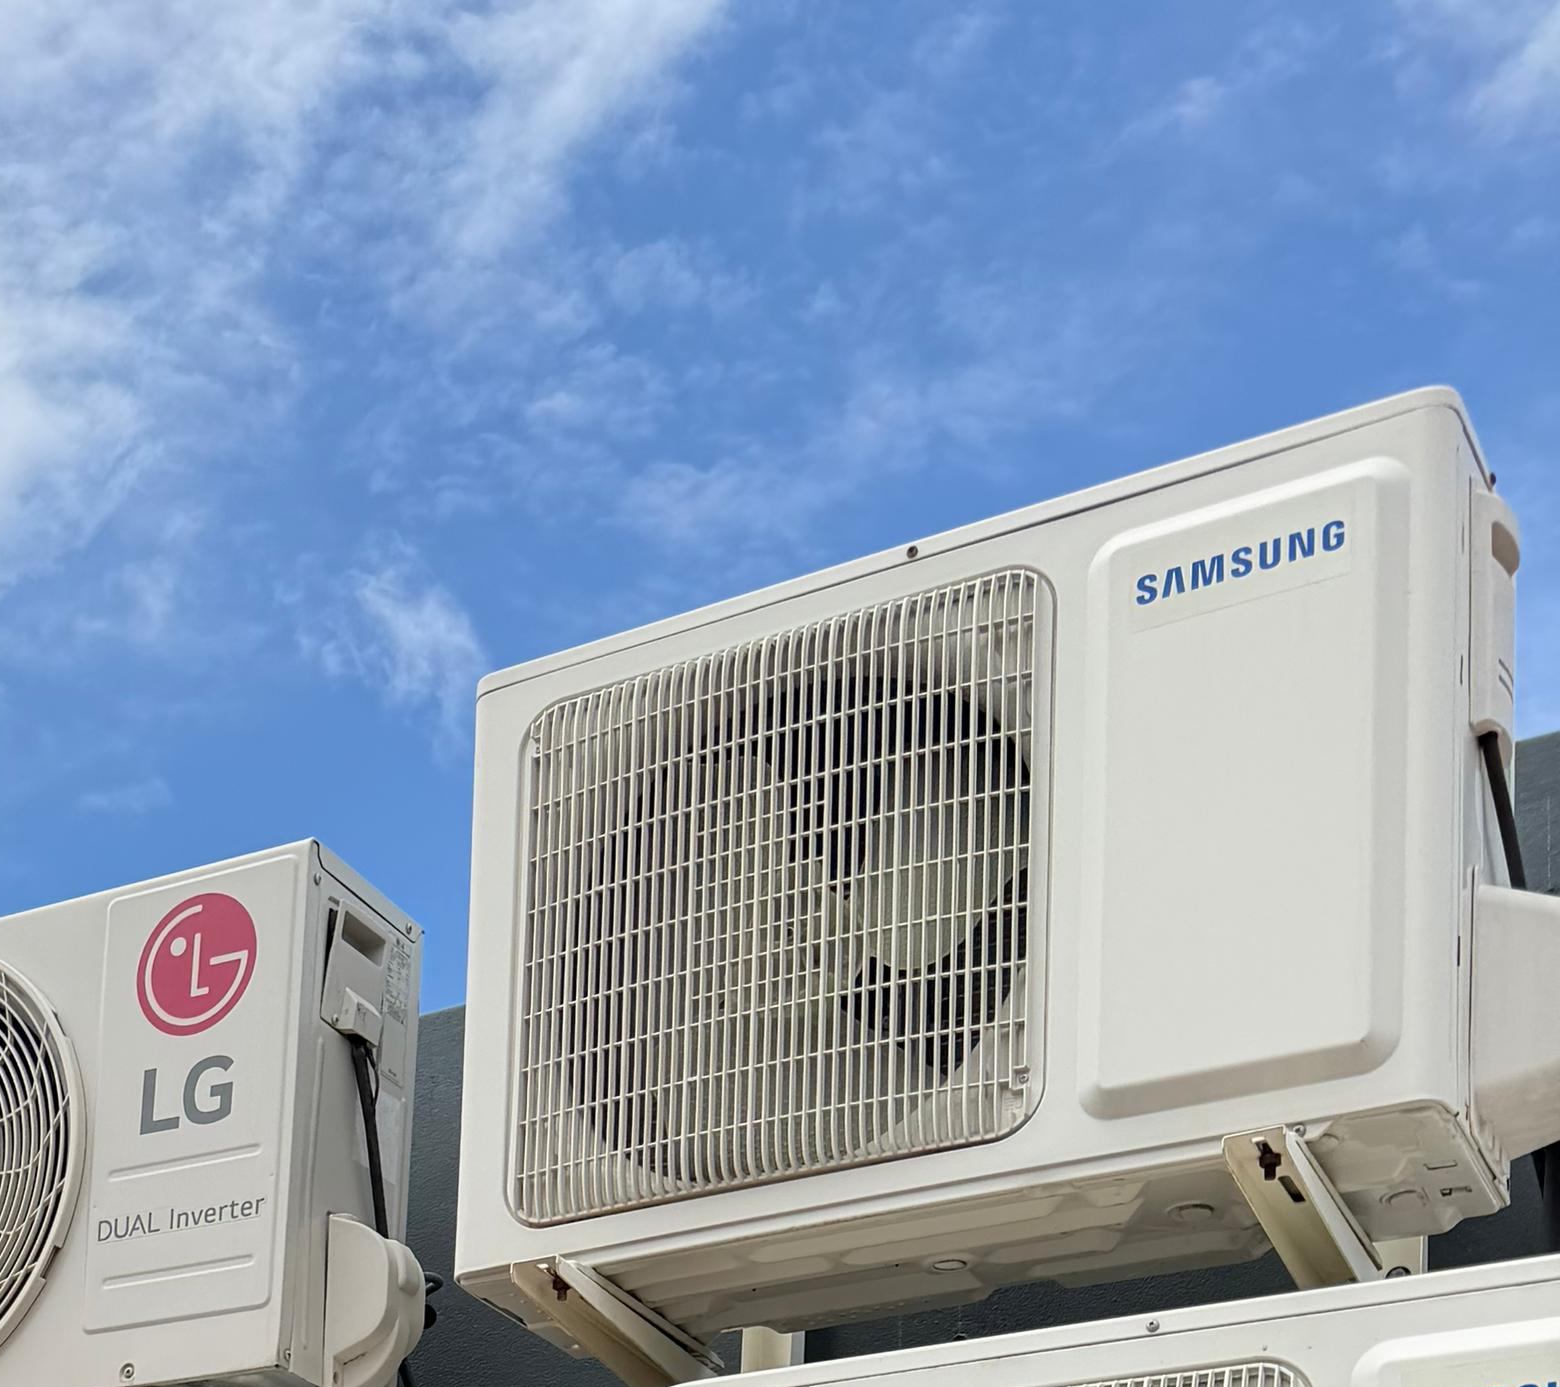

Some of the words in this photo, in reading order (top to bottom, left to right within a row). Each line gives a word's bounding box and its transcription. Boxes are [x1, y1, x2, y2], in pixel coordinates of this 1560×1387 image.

[1136, 519, 1345, 606] SAMSUNG
[140, 1055, 235, 1136] LG
[97, 1211, 161, 1242] DUAL
[169, 1197, 265, 1230] Inverter
